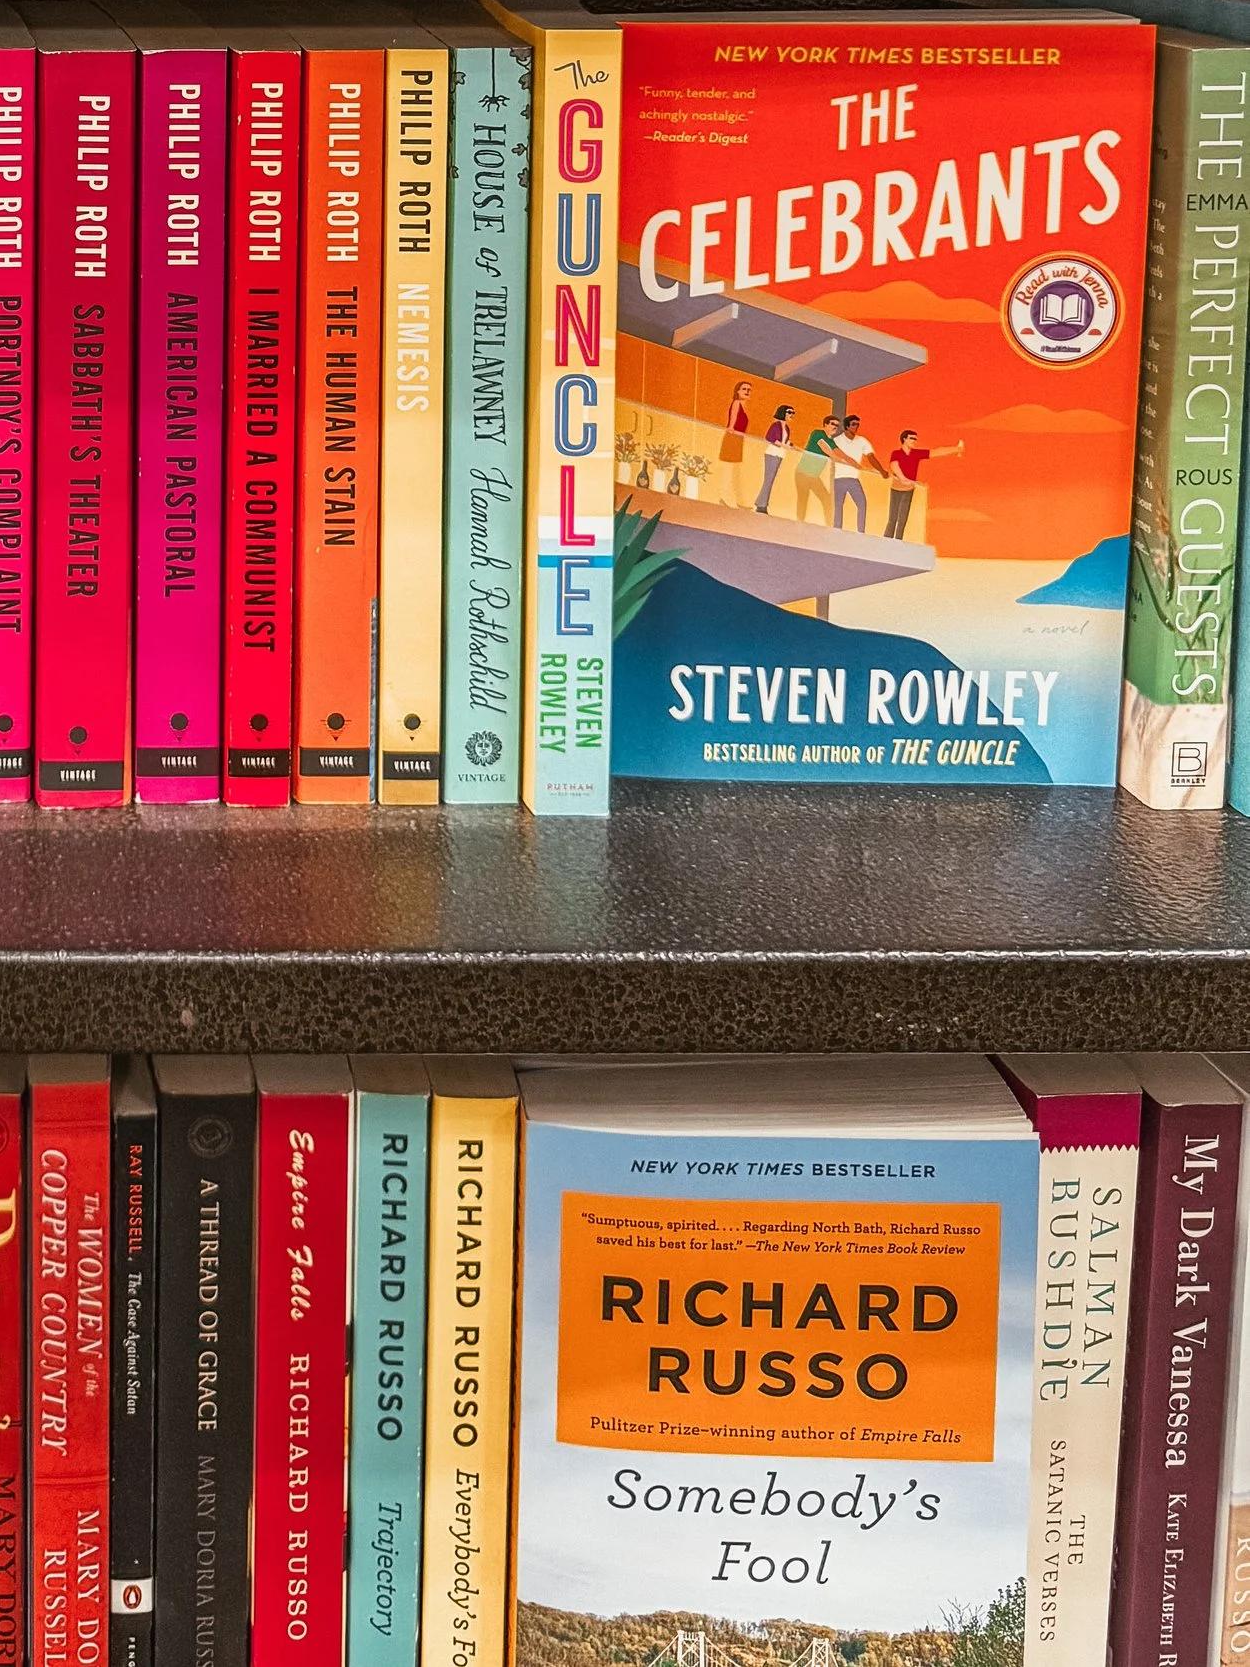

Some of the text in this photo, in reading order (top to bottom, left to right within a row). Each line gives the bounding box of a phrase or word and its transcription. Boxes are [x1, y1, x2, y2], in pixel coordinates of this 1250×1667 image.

[715, 46, 1061, 66] NEW YORK TIMES BESTSELLER
[733, 88, 755, 98] and
[639, 110, 688, 124] achingly
[831, 84, 919, 151] THE
[709, 133, 748, 146] Digest
[639, 130, 1122, 302] CELEBRANTS
[669, 664, 1059, 726] STEVEN ROWLEY
[704, 740, 1020, 766] BESTSELLING AUTHOR OF THE GUNCLE
[458, 773, 505, 782] VINTAGE
[630, 1160, 936, 1178] NEW YORK TIMES BESTSELLER
[601, 1275, 958, 1332] RICHARD
[649, 1347, 908, 1401] RUSSO
[590, 1417, 654, 1434] Pulitzer
[781, 1426, 835, 1440] author
[839, 1427, 857, 1440] of
[861, 1429, 918, 1445] Empire
[923, 1429, 961, 1444] Falls
[288, 1354, 309, 1639] RICHARD RUSSO
[1040, 1440, 1067, 1641] SATANIC VERSES
[370, 1503, 401, 1636] Trajectory
[712, 1541, 831, 1585] Fool
